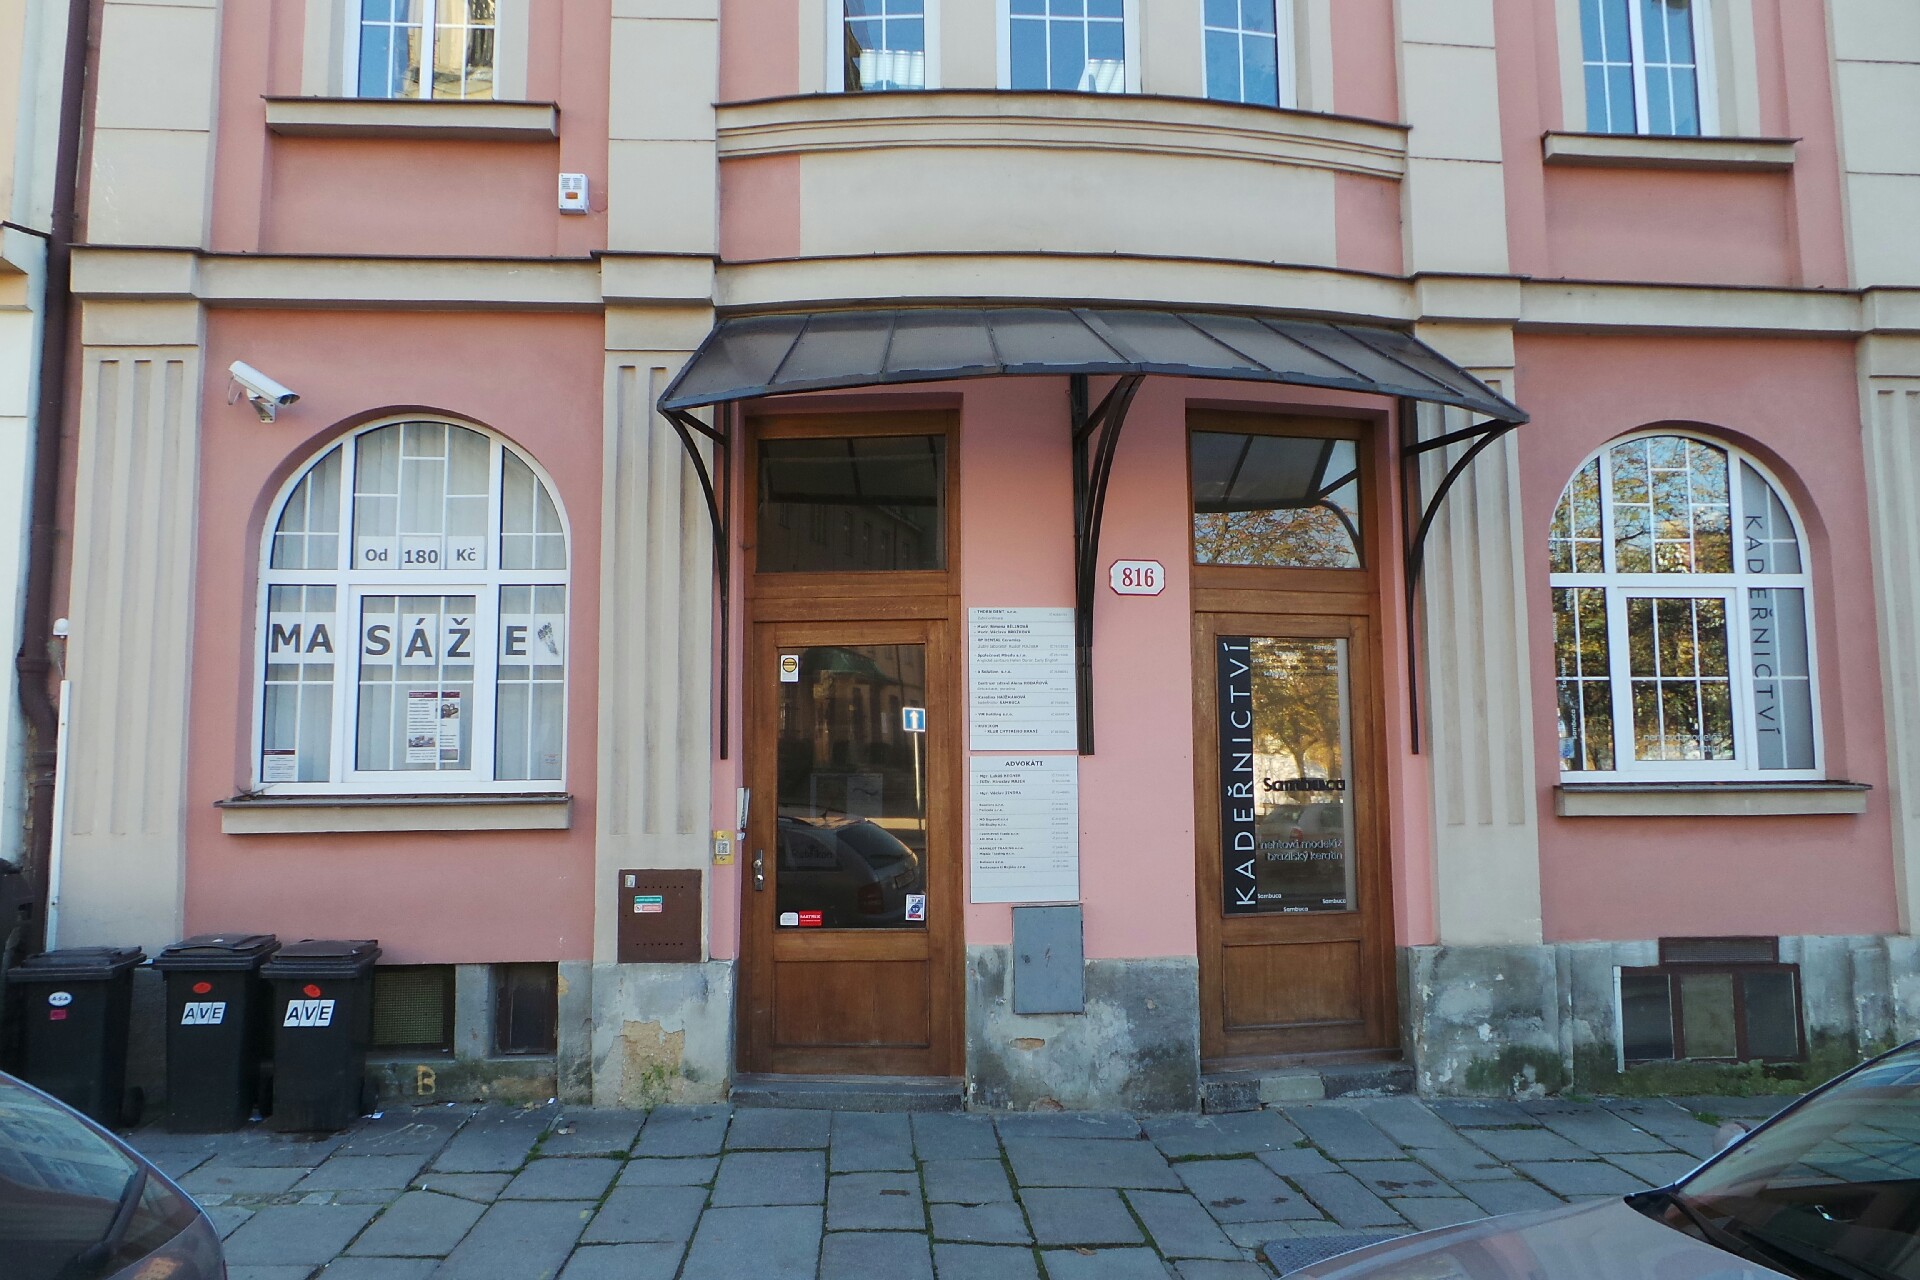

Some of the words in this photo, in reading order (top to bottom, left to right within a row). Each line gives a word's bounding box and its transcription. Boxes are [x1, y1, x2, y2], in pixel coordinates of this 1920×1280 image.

[365, 548, 388, 562] Od
[404, 549, 439, 564] 180
[456, 547, 476, 562] Kč
[1122, 567, 1155, 588] 816
[1005, 759, 1043, 767] ADVOKÁTI
[1223, 642, 1256, 905] KADEŘNICTVÍ
[184, 1007, 223, 1020] AVE
[286, 1006, 331, 1021] AVE
[417, 1065, 436, 1096] B
